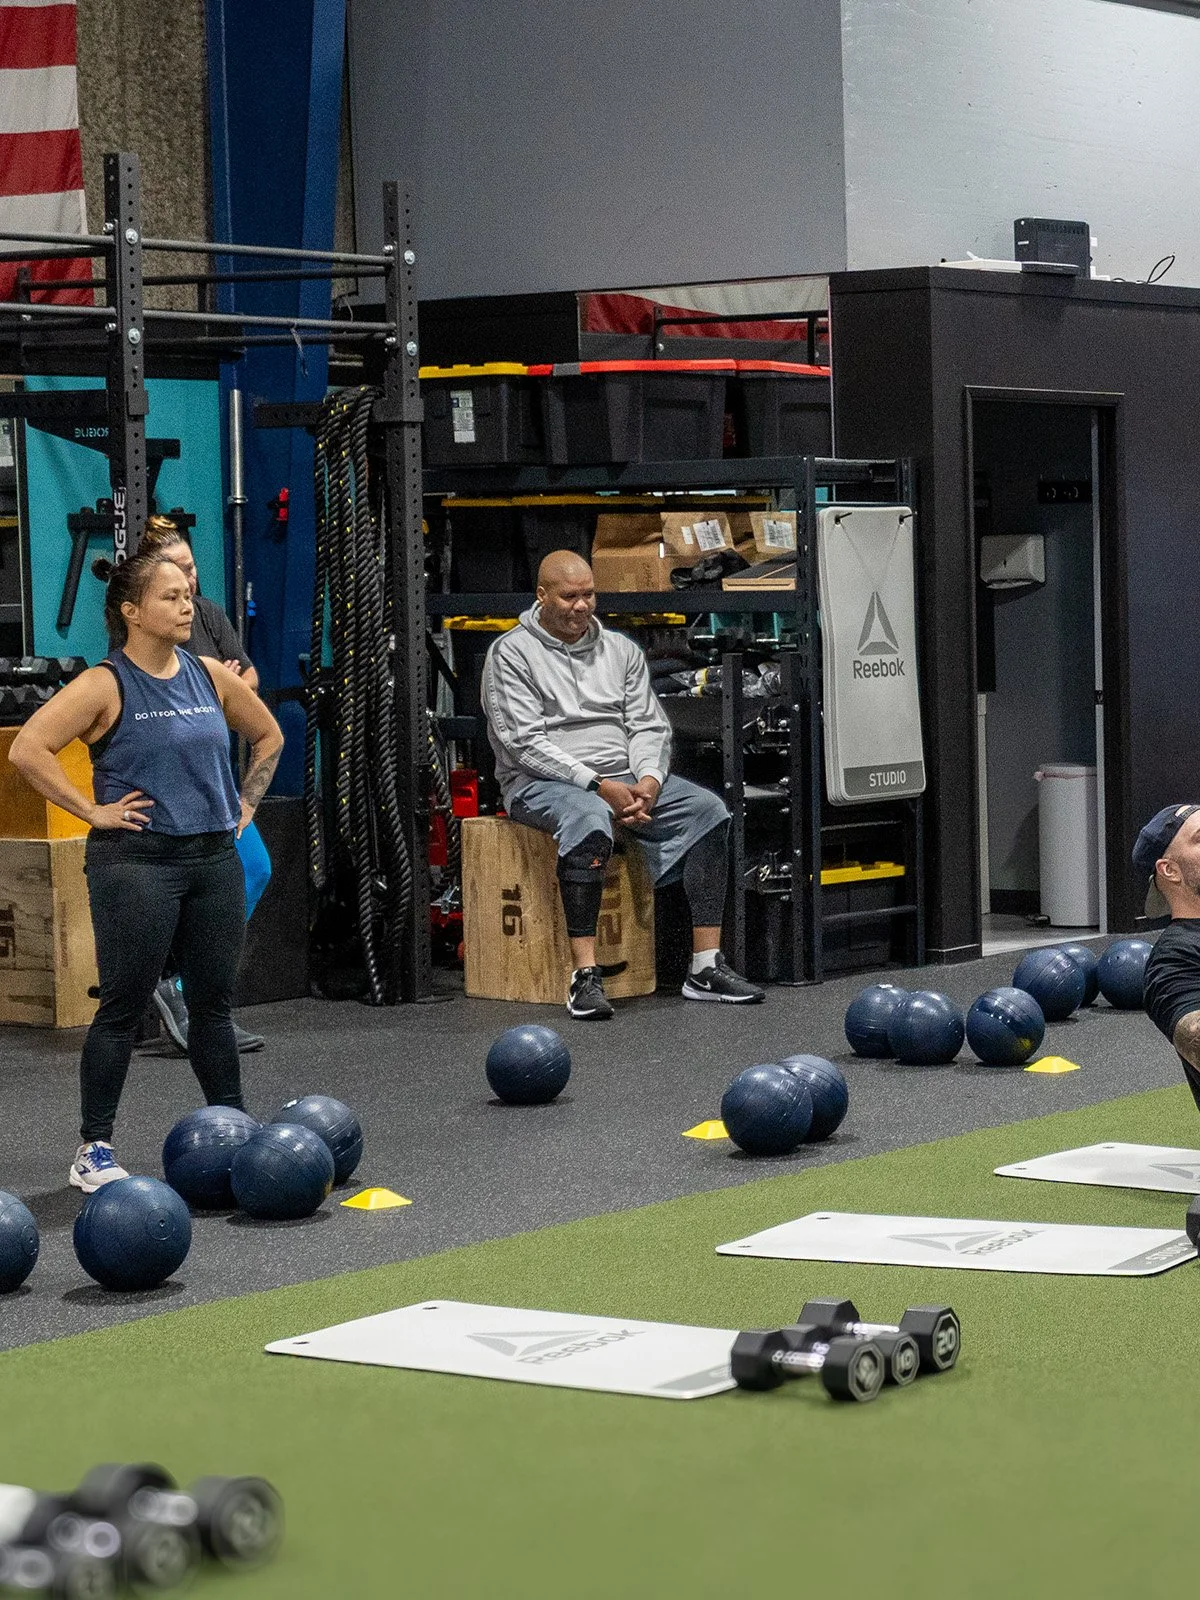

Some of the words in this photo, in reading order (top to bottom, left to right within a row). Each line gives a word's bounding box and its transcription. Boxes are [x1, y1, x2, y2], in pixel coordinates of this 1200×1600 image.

[114, 491, 127, 567] OGUE
[853, 658, 905, 679] Reebok
[135, 712, 149, 721] DO
[177, 708, 193, 716] THE
[869, 770, 906, 787] STUDIO
[516, 1328, 647, 1365] Reebok
[936, 1326, 957, 1356] 20
